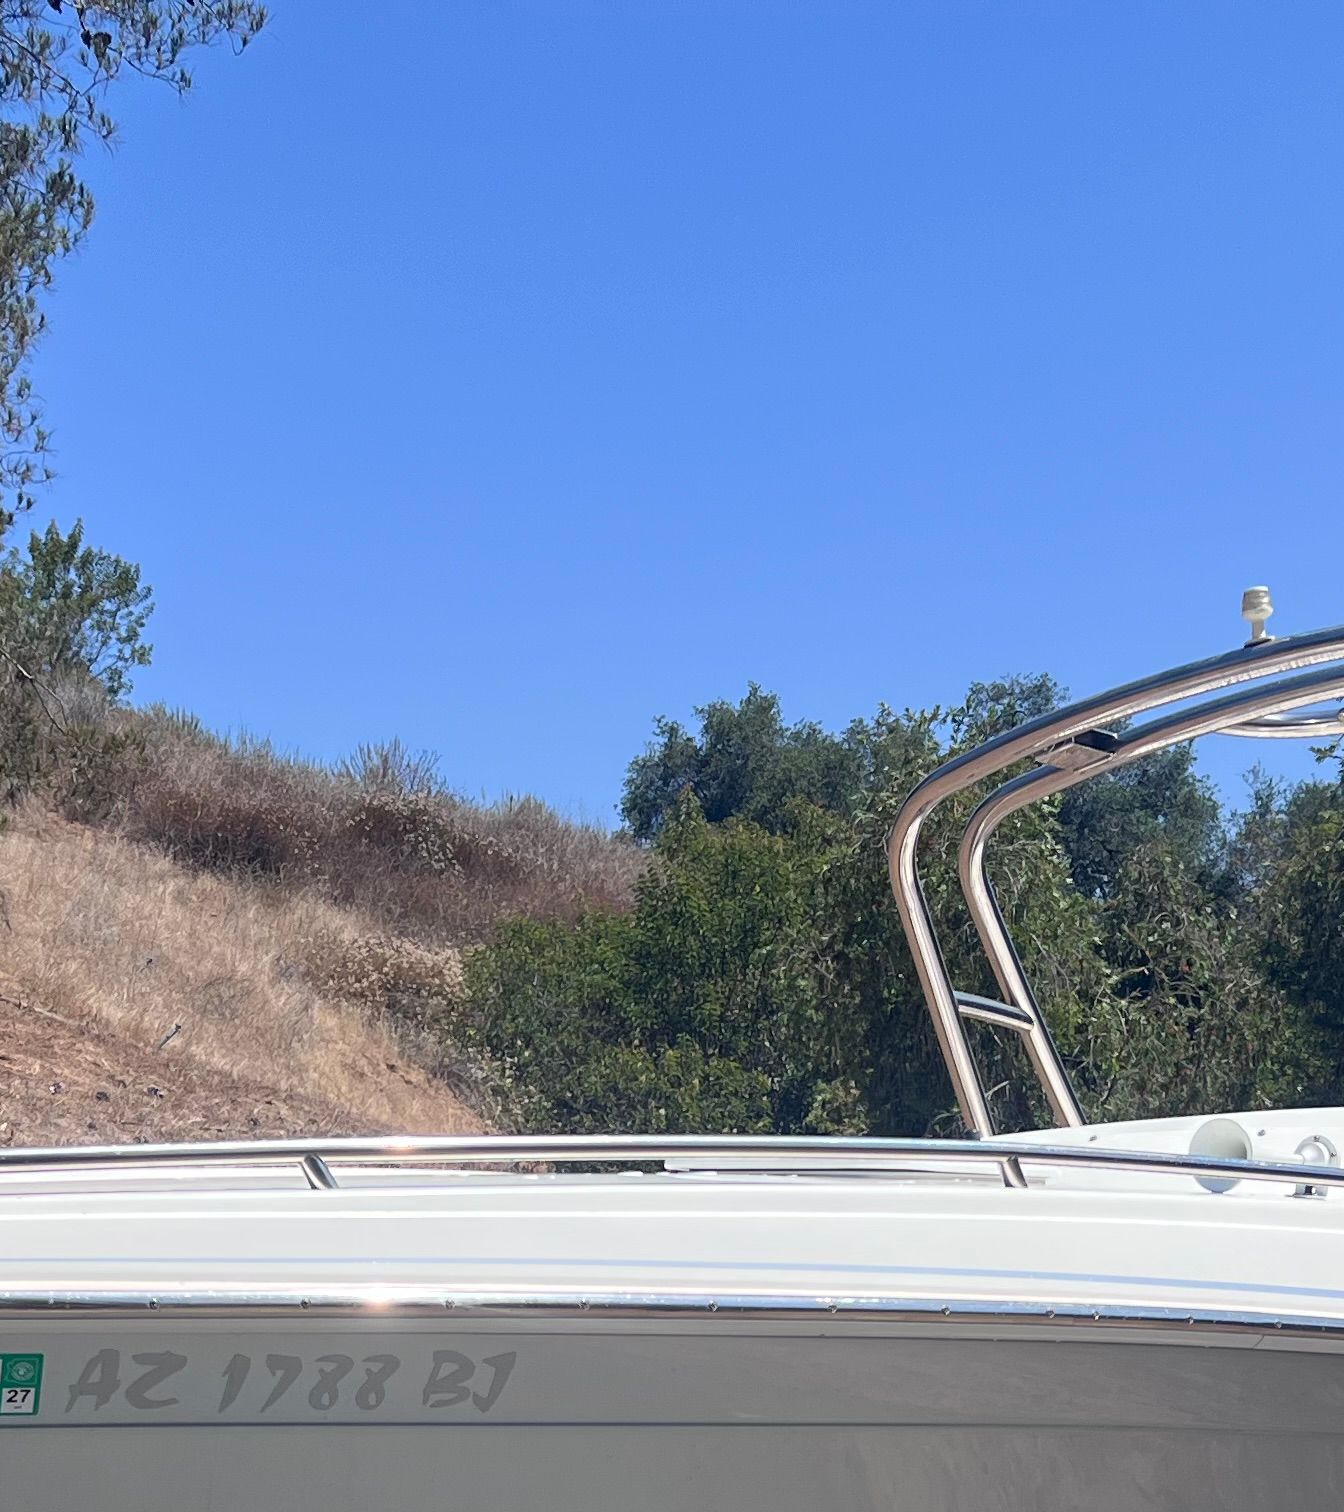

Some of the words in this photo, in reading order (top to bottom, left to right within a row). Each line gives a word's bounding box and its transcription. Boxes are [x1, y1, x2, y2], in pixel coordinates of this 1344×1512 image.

[6, 1389, 31, 1403] 27
[65, 1348, 187, 1411] AZ
[219, 1353, 401, 1413] 1788
[423, 1349, 516, 1413] BJ
